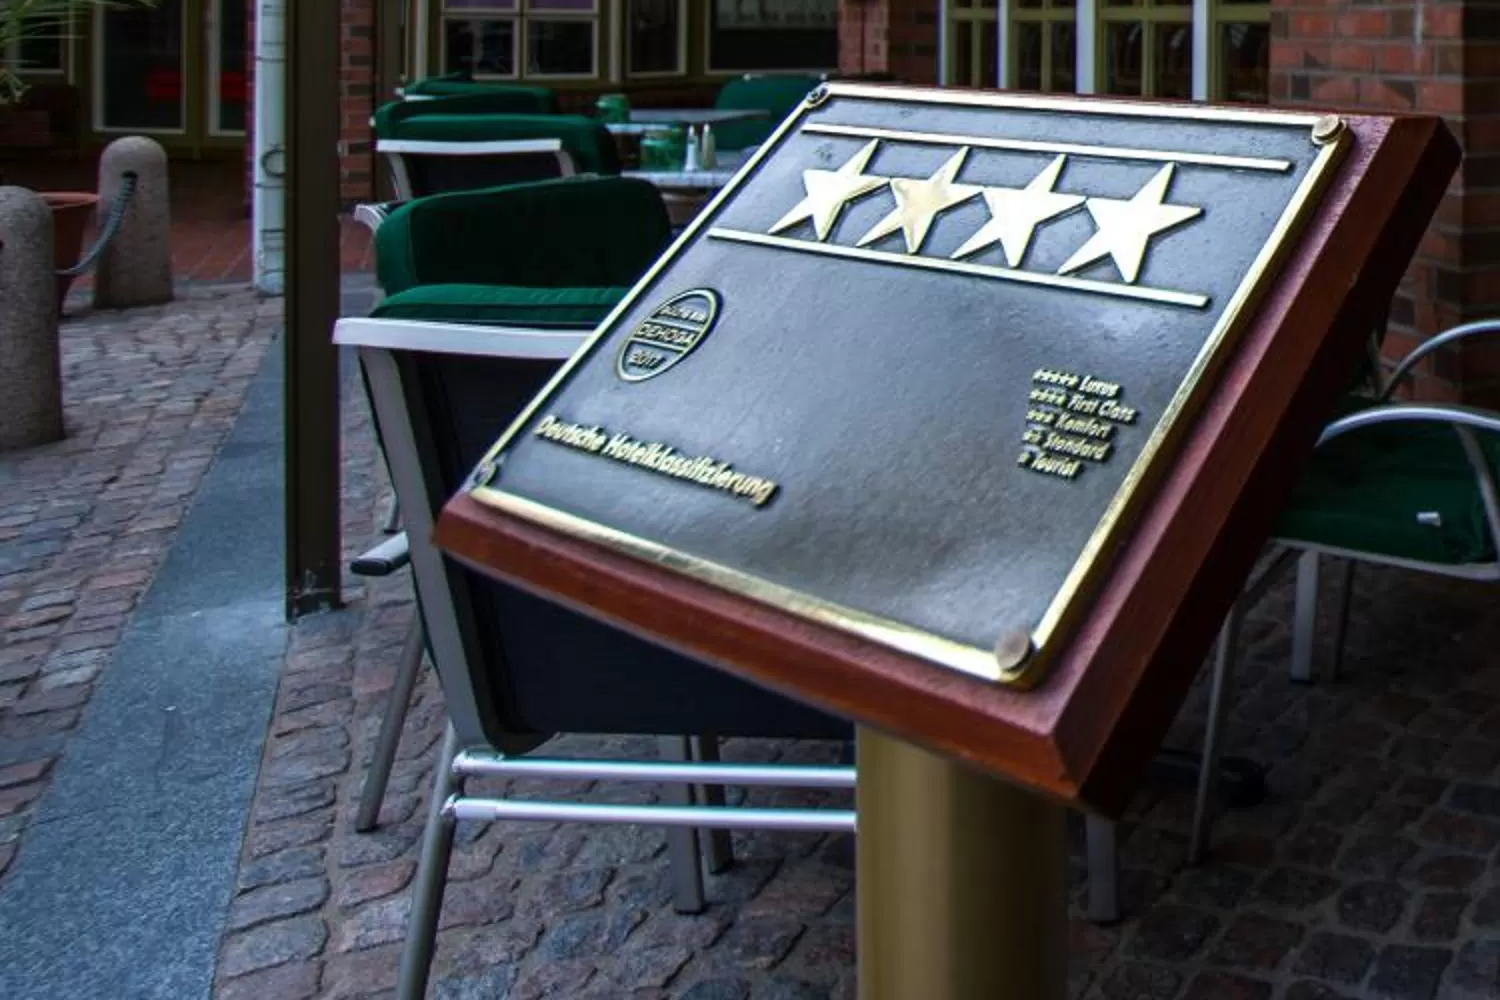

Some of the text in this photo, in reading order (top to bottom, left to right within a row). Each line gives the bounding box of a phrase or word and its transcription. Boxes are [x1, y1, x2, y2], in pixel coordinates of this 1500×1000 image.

[637, 322, 698, 346] DEHOGA
[1080, 375, 1120, 397] Luxus
[1068, 393, 1136, 421] First Class
[1055, 412, 1113, 438] Komfort
[1044, 431, 1111, 460] Standard
[533, 415, 778, 506] Deutsche Hotelklassifizierung
[1031, 451, 1081, 477] Tourist
